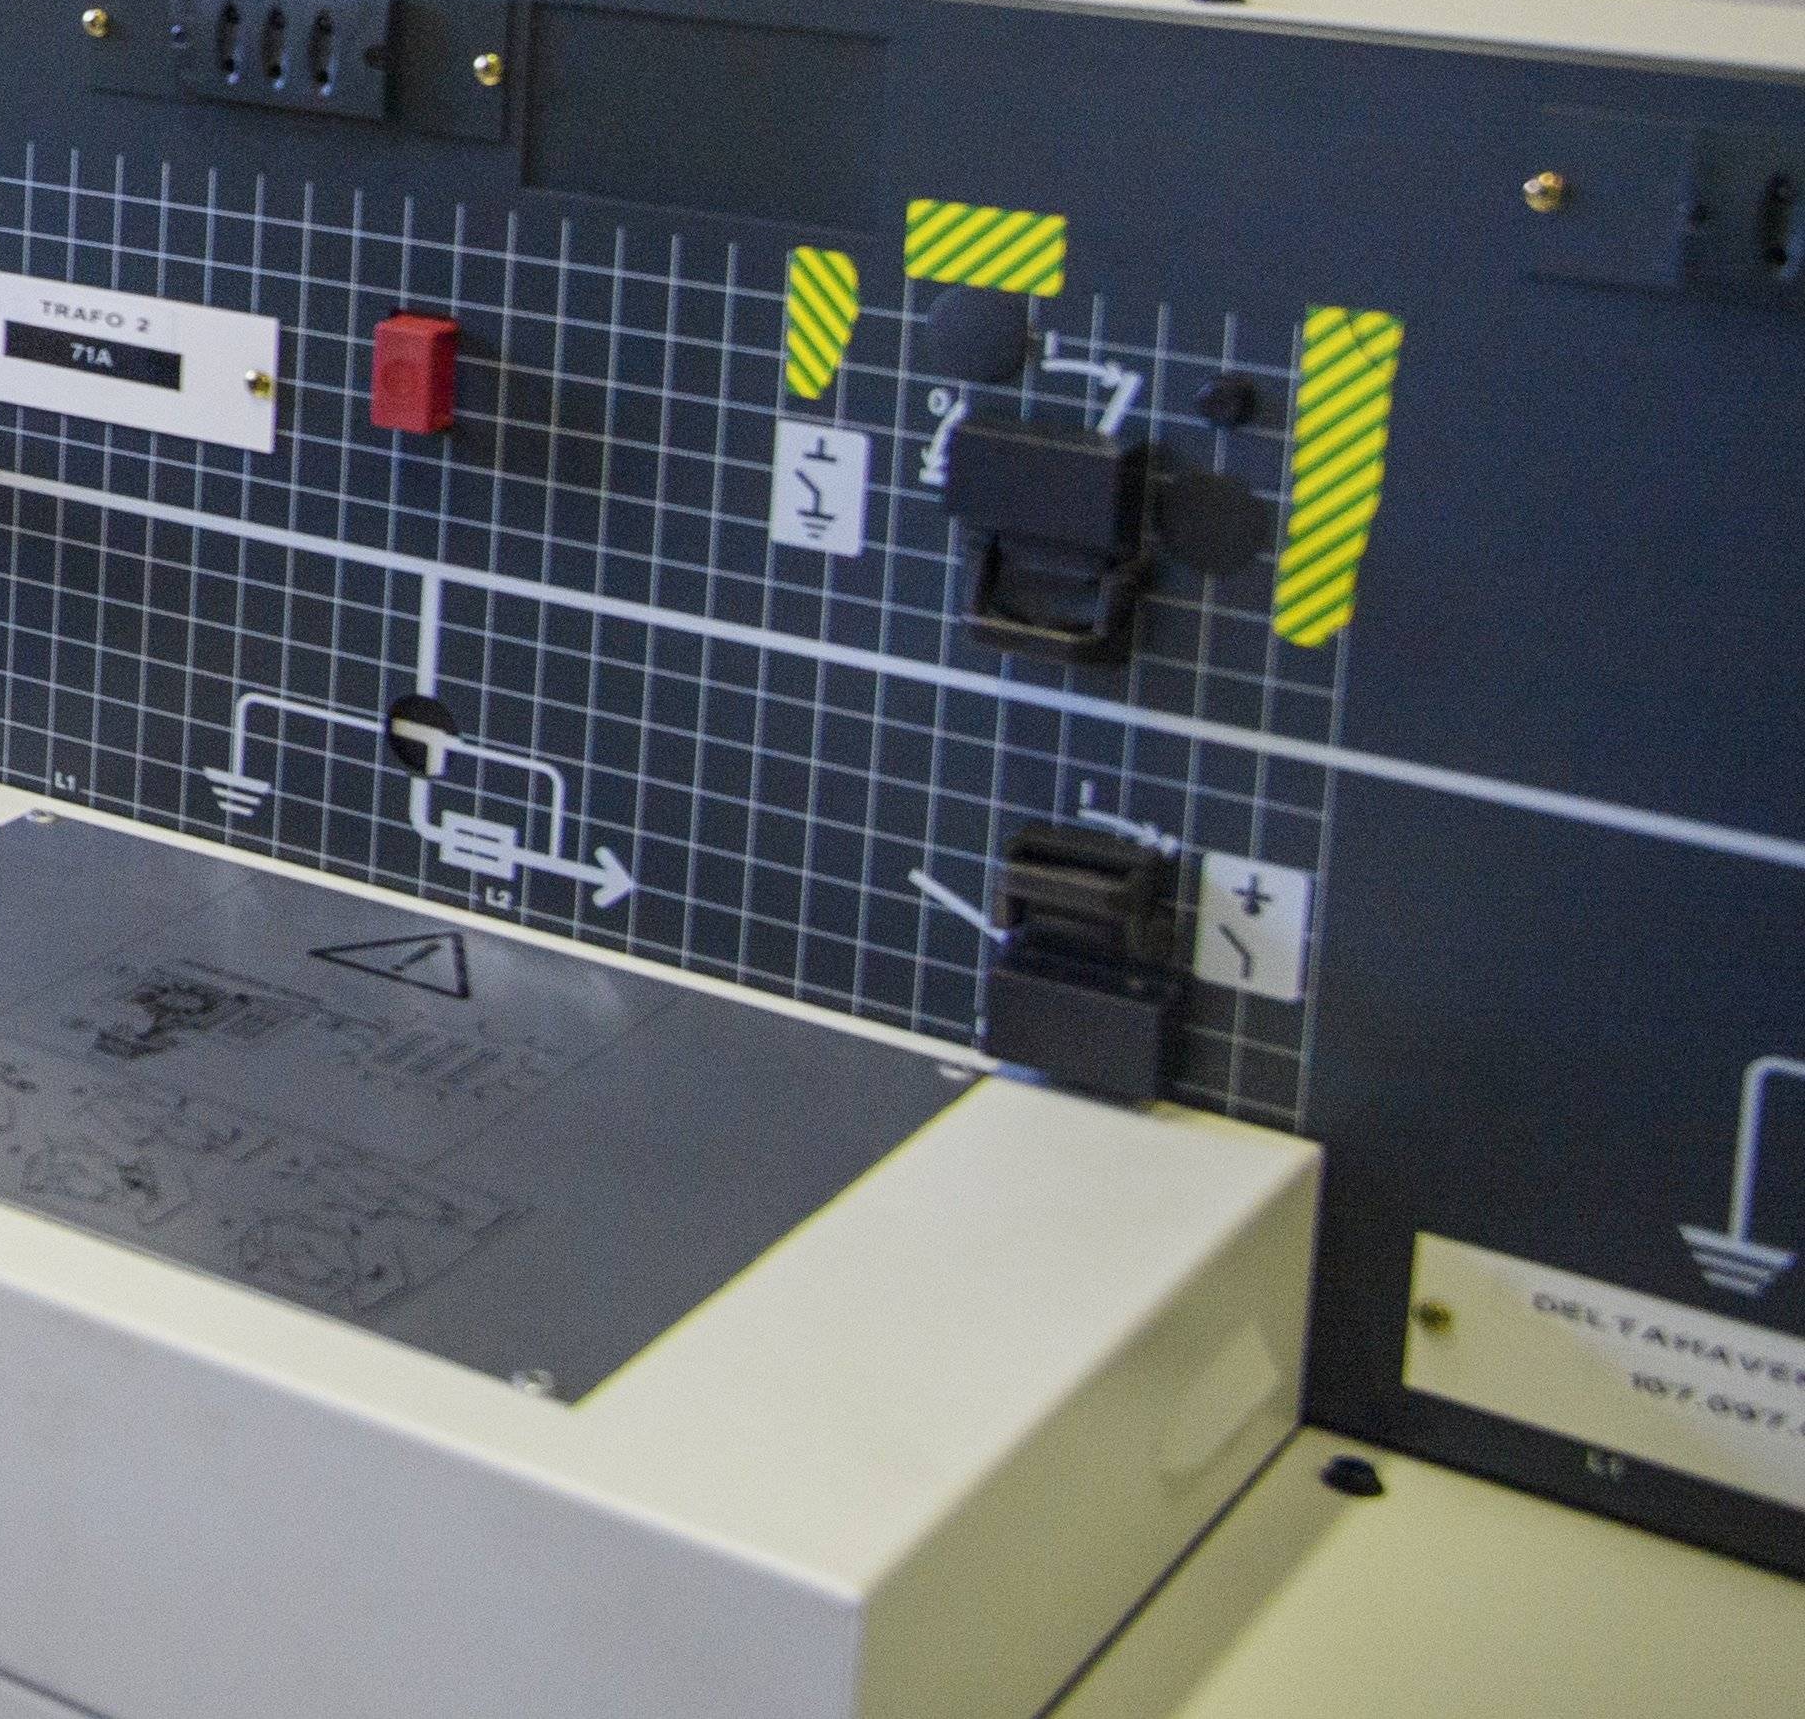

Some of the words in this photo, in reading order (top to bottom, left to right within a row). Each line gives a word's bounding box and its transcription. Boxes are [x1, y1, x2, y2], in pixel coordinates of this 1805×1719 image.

[41, 298, 124, 329] TRAFO
[137, 316, 150, 332] 2
[71, 341, 113, 368] 71A
[54, 770, 77, 793] L1
